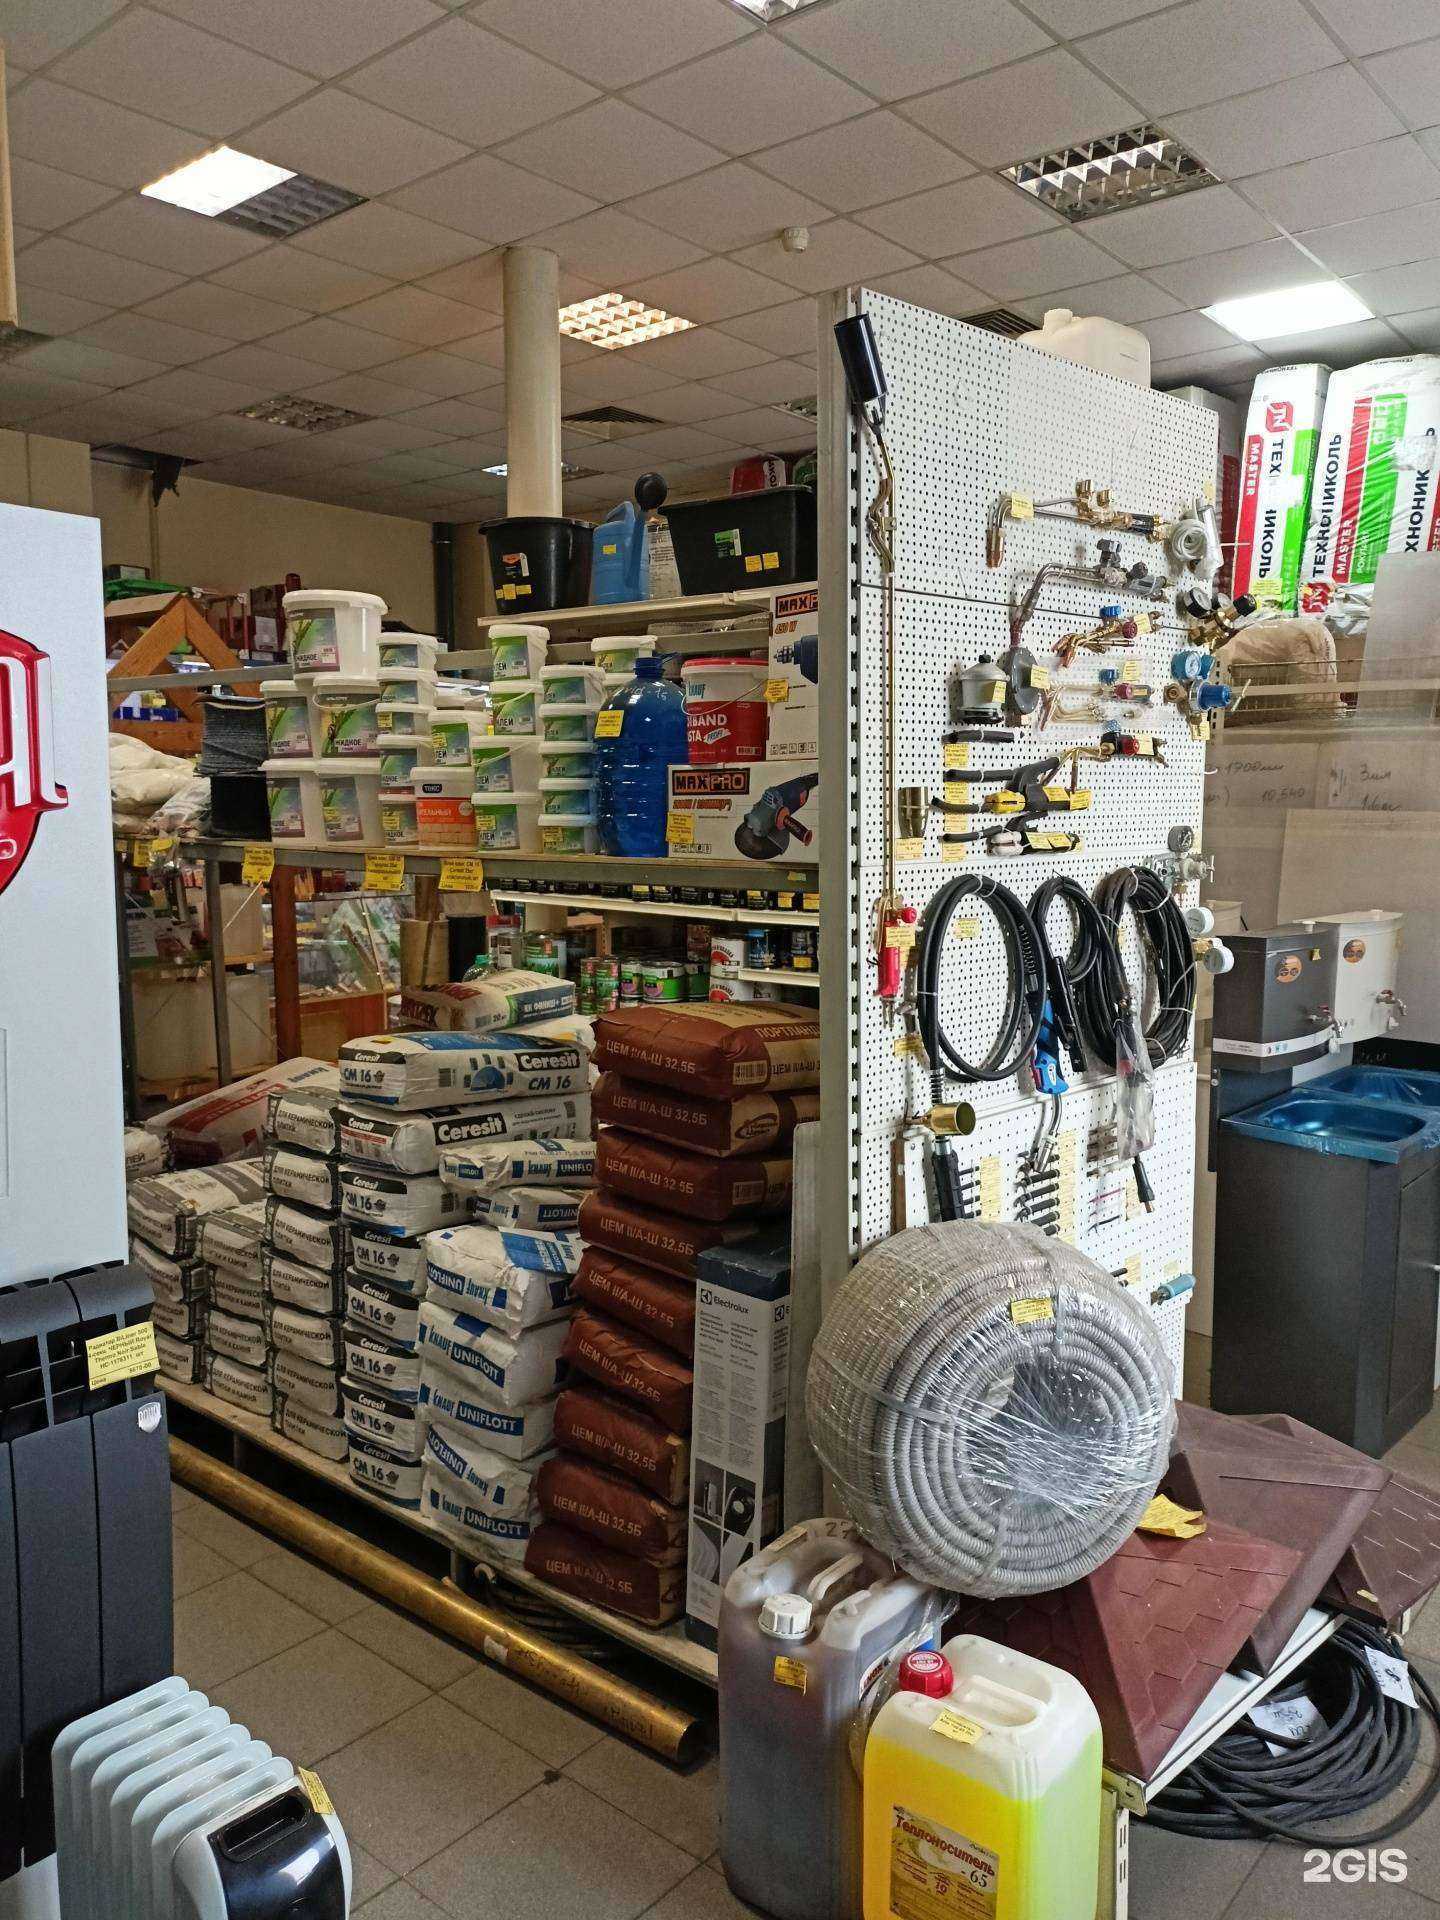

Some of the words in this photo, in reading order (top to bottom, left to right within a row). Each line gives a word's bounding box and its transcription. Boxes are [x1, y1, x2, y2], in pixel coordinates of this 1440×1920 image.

[1245, 442, 1261, 495] MASTER
[520, 1052, 578, 1070] Ceresit
[607, 1039, 629, 1056] ЦЕМ
[664, 1056, 696, 1074] 32,5Б
[360, 1069, 372, 1083] 16
[556, 1075, 571, 1089] 16
[612, 1094, 636, 1109] ЦЕМ
[675, 1109, 708, 1127] 32,5Б
[348, 1118, 375, 1132] Ceresit
[437, 1116, 503, 1143] Ceresit
[606, 1157, 628, 1175] ЦЕМ
[360, 1196, 372, 1211] 16
[600, 1216, 624, 1234] ЦЕМ
[661, 1236, 694, 1256] 32,5Б
[372, 1249, 386, 1265] 16
[589, 1270, 611, 1291] ЦЕМ
[362, 1283, 390, 1302] Ceresit
[369, 1304, 382, 1321] 16
[713, 1296, 749, 1314] Electrolux
[360, 1338, 390, 1354] Ceresit
[578, 1338, 601, 1361] ЦЕМ
[368, 1358, 382, 1374] 16
[454, 1347, 499, 1380] UNIFLOTT
[359, 1394, 386, 1410] Ceresit
[368, 1415, 382, 1431] 16
[459, 1406, 516, 1432] UNIFLOTT
[571, 1423, 594, 1441] ЦЕМ
[371, 1464, 384, 1481] 16
[553, 1494, 578, 1512] ЦЕМ
[466, 1512, 522, 1536] UNIFLOTT
[546, 1559, 570, 1576] ЦЕМ
[896, 1814, 996, 1877] Теплоноситель
